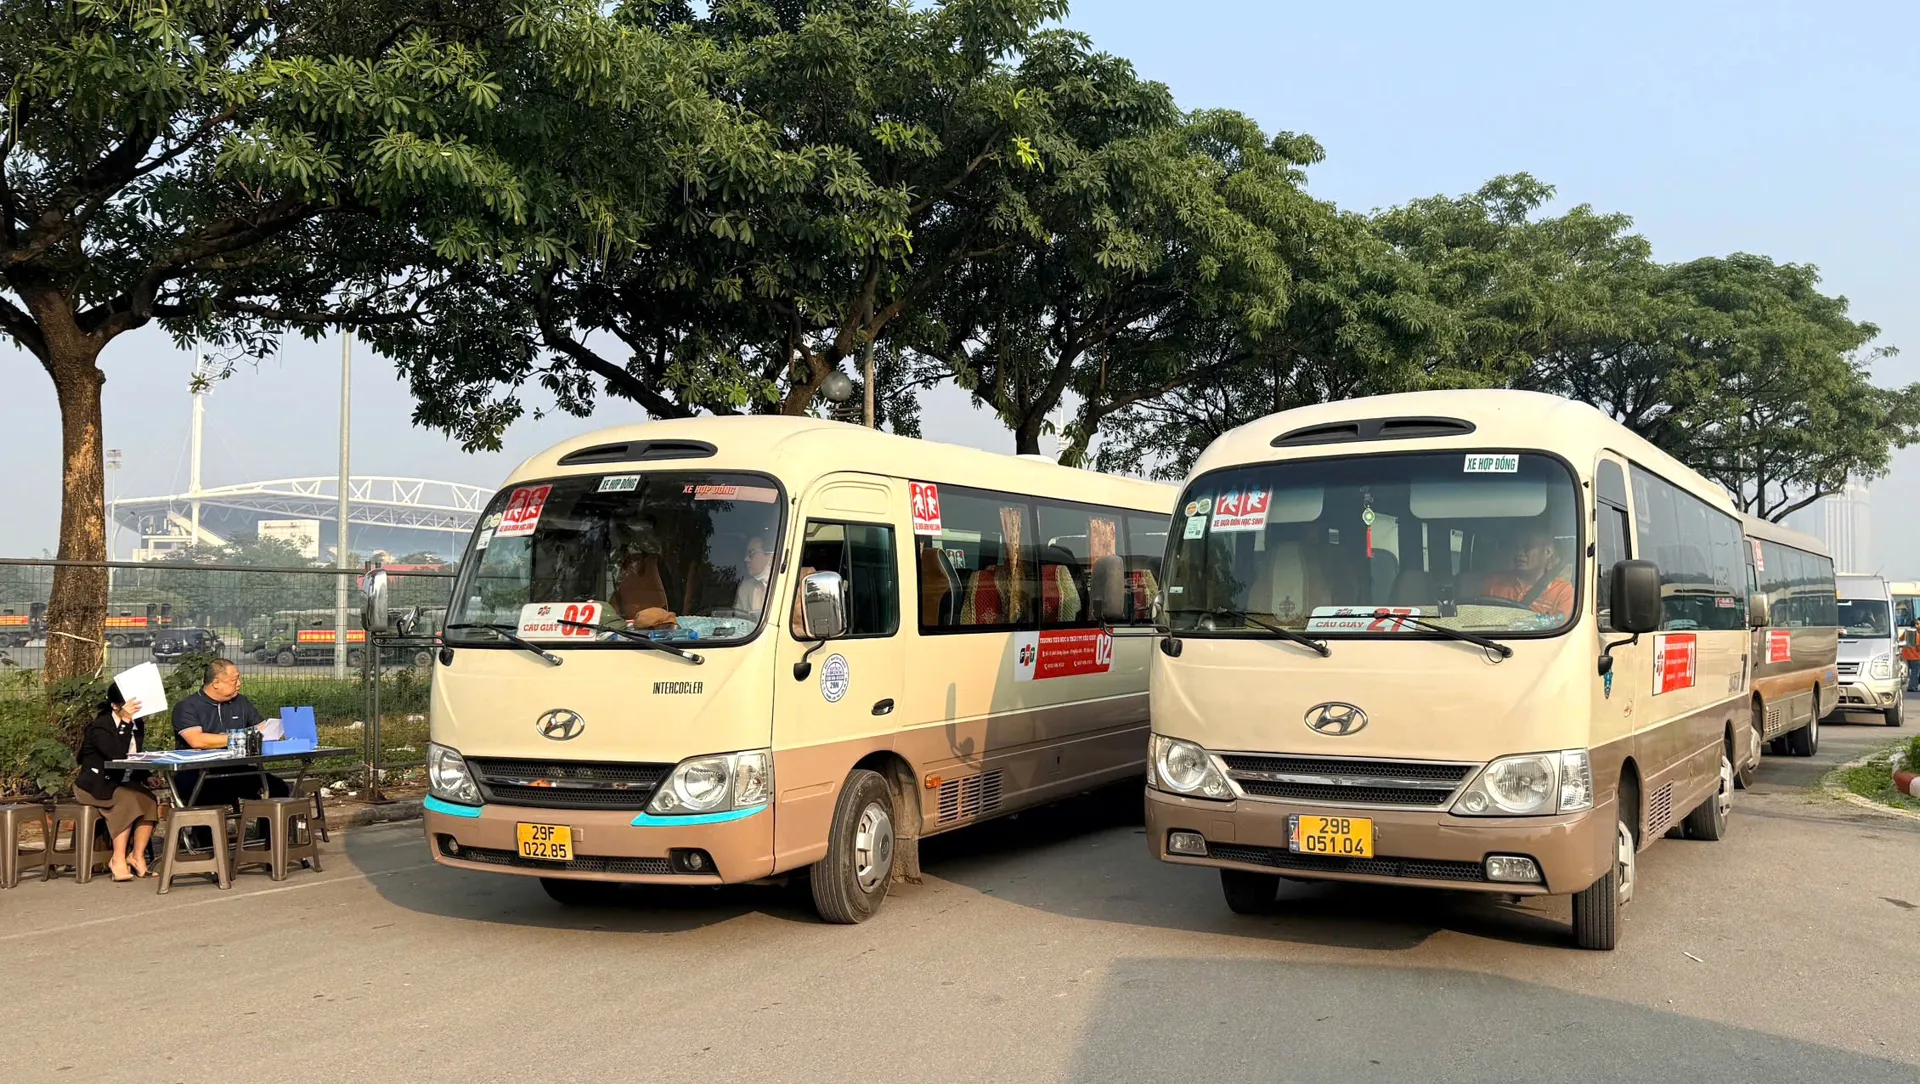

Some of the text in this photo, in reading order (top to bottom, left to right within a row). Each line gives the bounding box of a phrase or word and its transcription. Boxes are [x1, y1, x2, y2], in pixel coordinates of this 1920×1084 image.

[1467, 457, 1477, 470] XE
[682, 485, 694, 494] XE
[561, 604, 595, 636] 02
[1366, 608, 1412, 632] 27
[1095, 633, 1112, 666] 02
[532, 825, 555, 841] 29F
[1319, 818, 1351, 835] 29B
[523, 842, 567, 859] 022.85
[1307, 835, 1364, 854] 051.04
